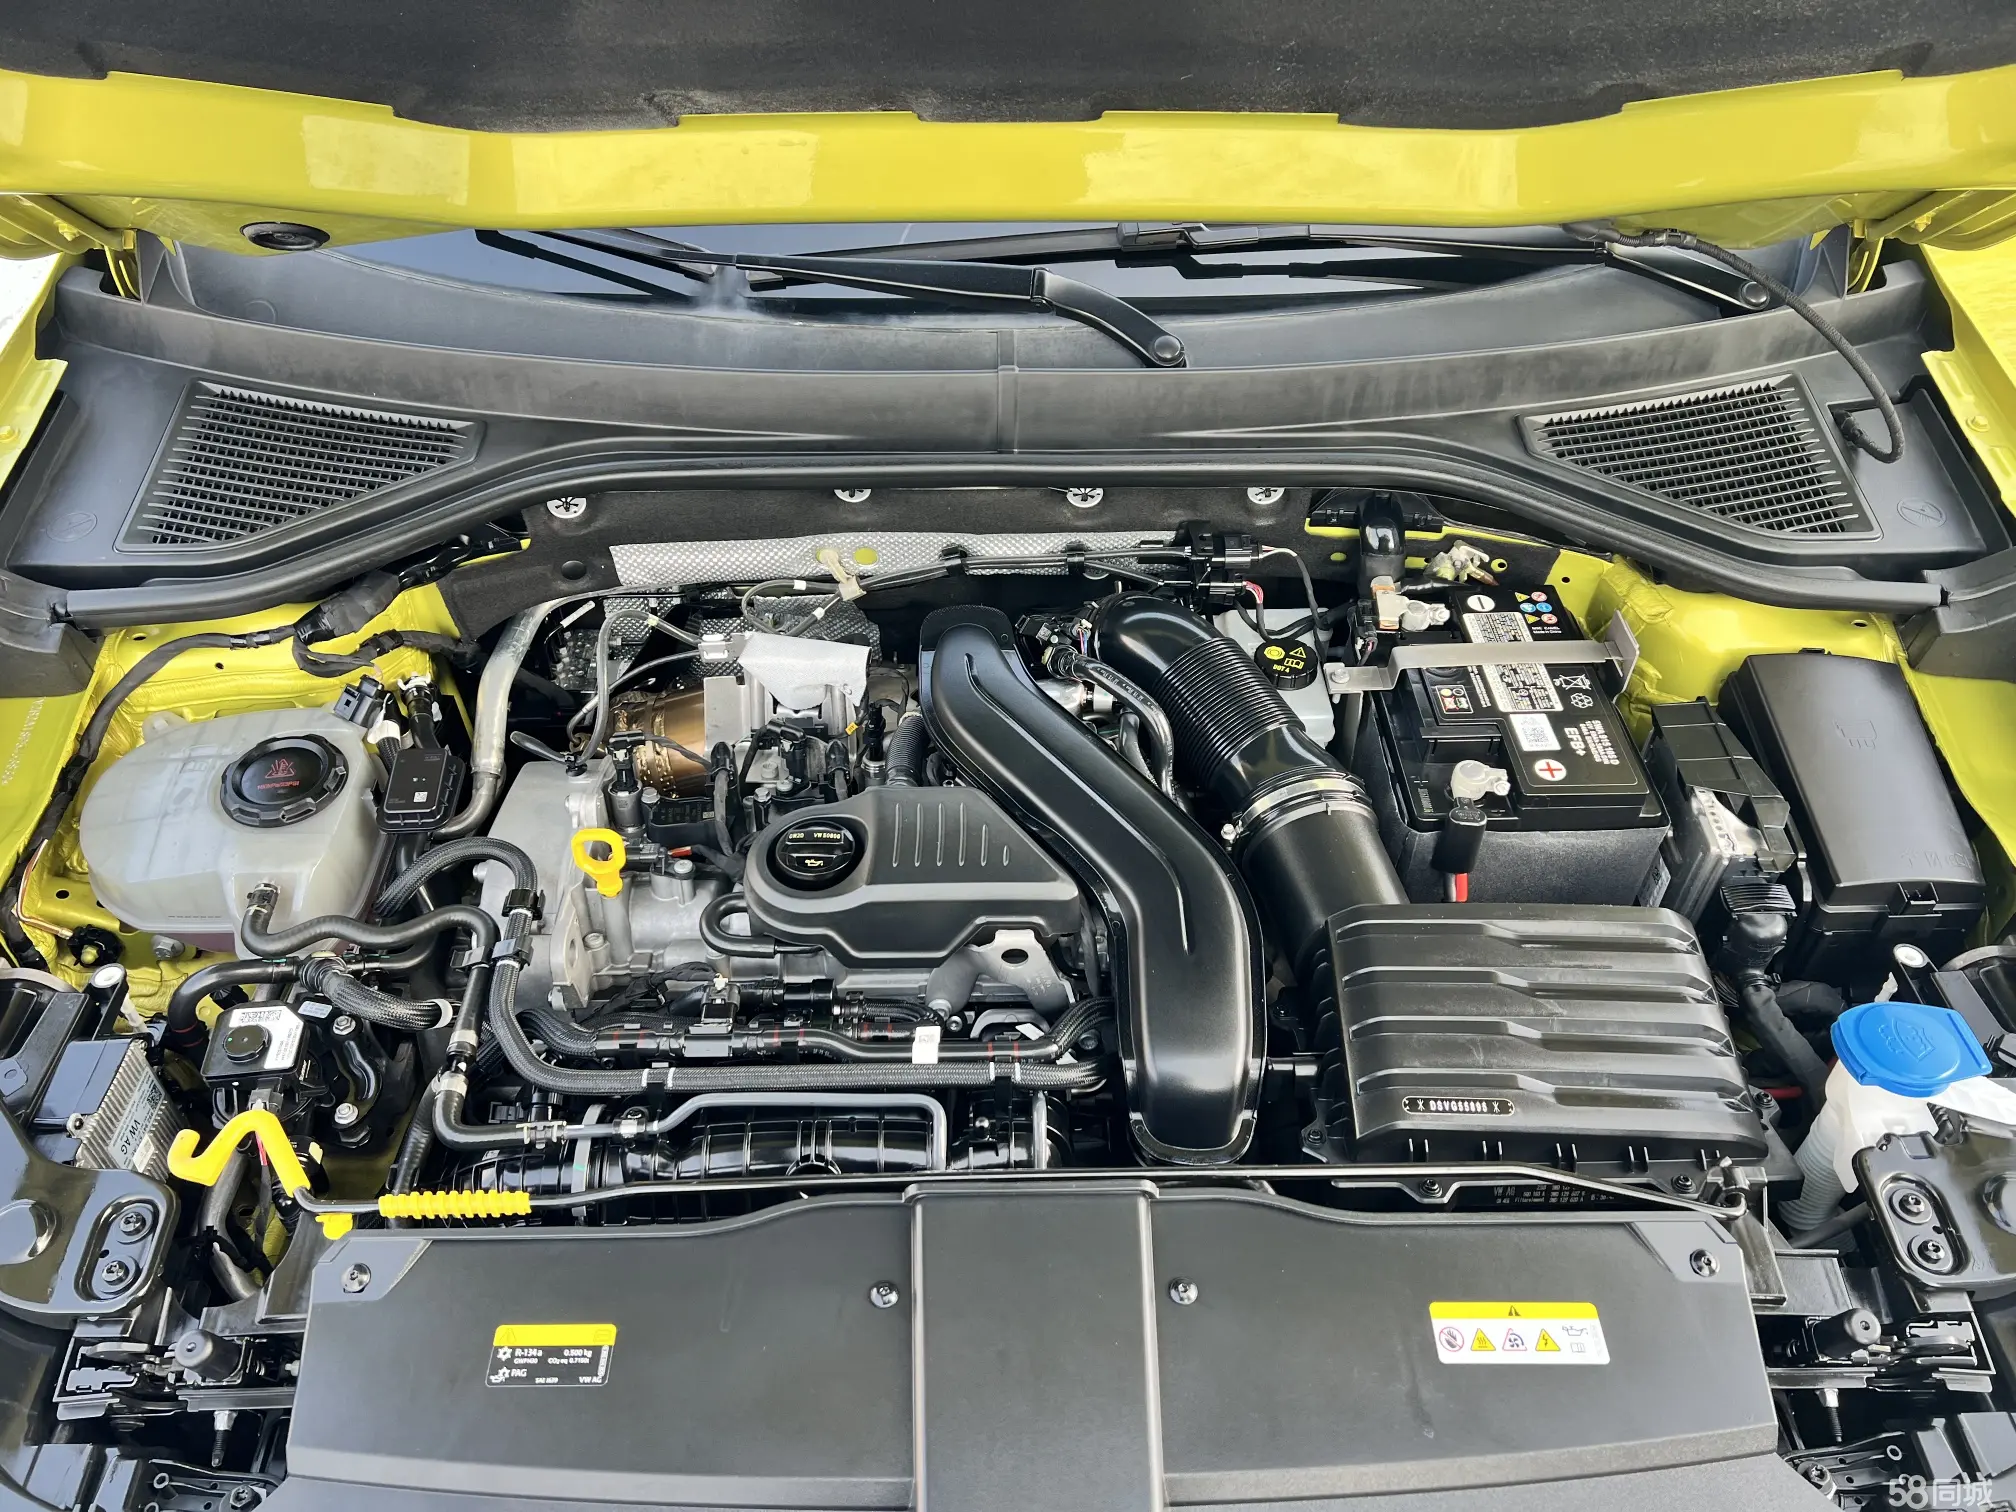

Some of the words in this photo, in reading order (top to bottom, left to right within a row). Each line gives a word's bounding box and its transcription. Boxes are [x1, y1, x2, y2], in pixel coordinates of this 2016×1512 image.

[1564, 727, 1587, 757] EFB+
[127, 1118, 141, 1138] VW
[120, 1138, 131, 1156] AG
[515, 1349, 543, 1357] R-134a
[563, 1349, 583, 1357] 0.500
[583, 1349, 593, 1358] kg
[511, 1368, 527, 1377] PAG
